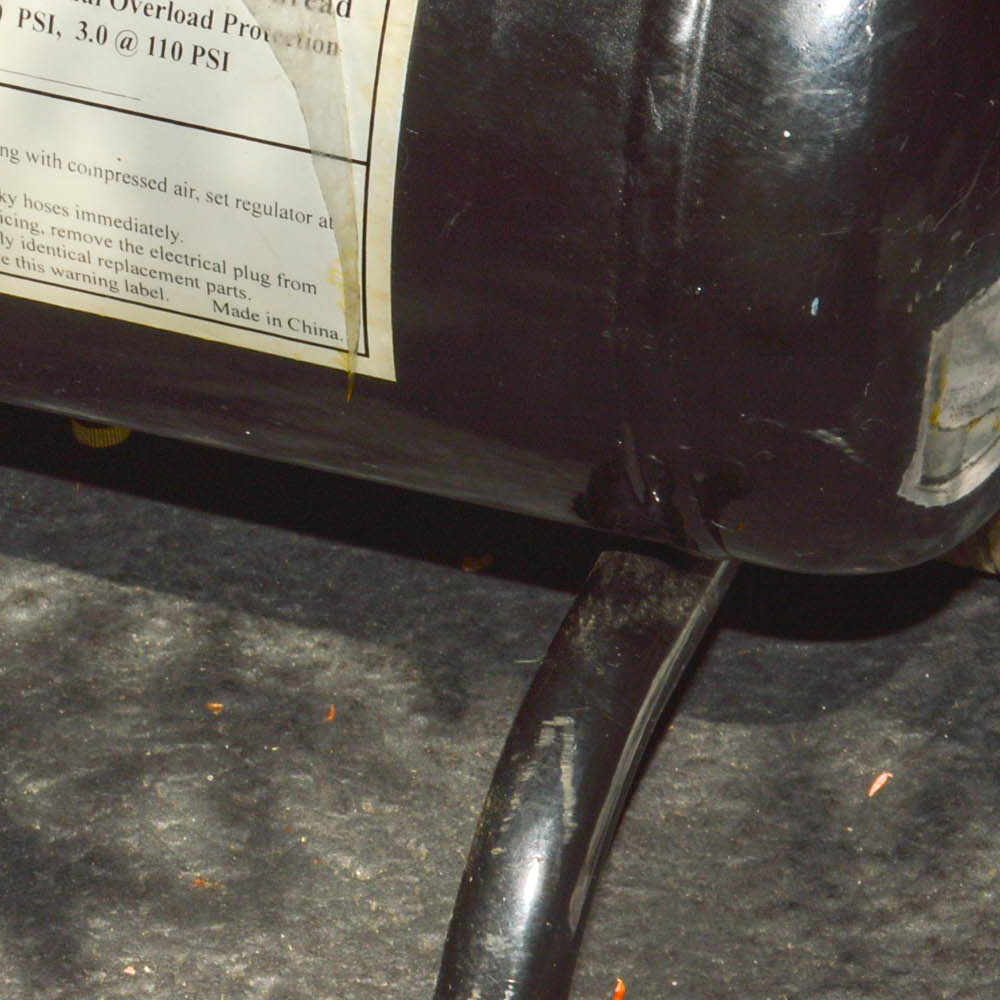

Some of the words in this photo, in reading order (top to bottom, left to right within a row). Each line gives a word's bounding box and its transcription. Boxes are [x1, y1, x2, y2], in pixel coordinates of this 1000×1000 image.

[17, 7, 62, 39] PSI,
[75, 20, 108, 46] 3.0
[114, 29, 139, 57] @
[147, 35, 183, 62] 110
[191, 44, 230, 73] PSI
[23, 193, 69, 217] hoses
[75, 204, 183, 245] immediately.
[25, 150, 62, 169] with
[67, 161, 167, 193] compressed
[205, 191, 229, 207] set
[235, 197, 313, 225] regulator
[318, 215, 335, 231] at
[15, 255, 45, 273] this
[50, 266, 120, 294] warning
[124, 279, 169, 302] label.
[21, 237, 91, 265] identical
[97, 257, 201, 289] replacement
[205, 281, 252, 301] parts.
[51, 226, 113, 249] remove
[119, 237, 144, 256] the
[149, 245, 227, 275] electrical
[233, 264, 271, 289] plug
[277, 272, 317, 295] from
[212, 299, 261, 323] Made
[266, 311, 283, 329] in
[287, 317, 344, 342] China.
